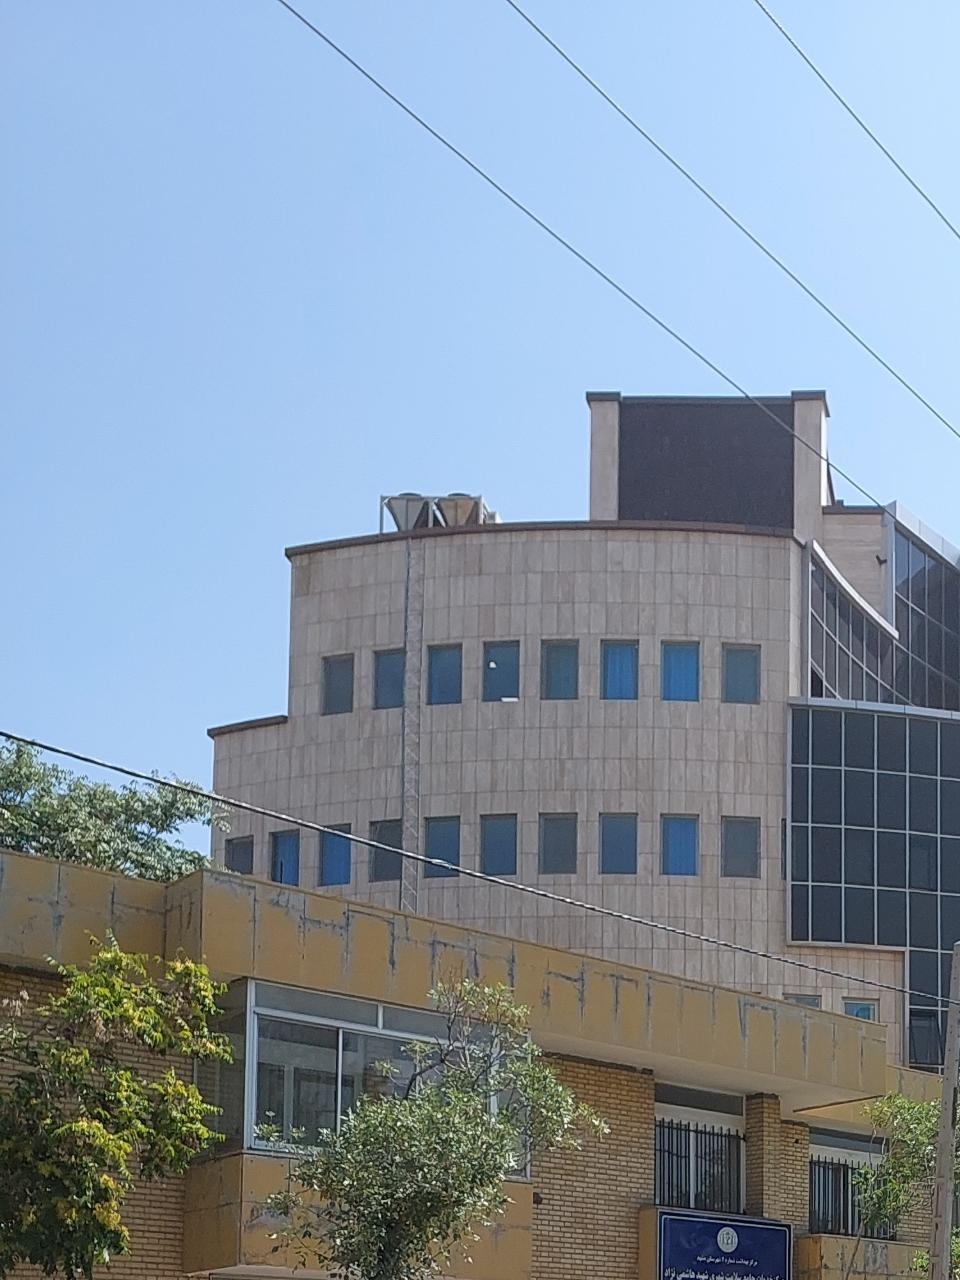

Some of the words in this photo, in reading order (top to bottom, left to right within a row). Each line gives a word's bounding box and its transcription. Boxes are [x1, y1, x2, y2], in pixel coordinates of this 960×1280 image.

[749, 1258, 758, 1267] مرکز
[664, 1266, 676, 1280] نژاد
[676, 1268, 696, 1280] هاشمی
[696, 1269, 709, 1280] شهید
